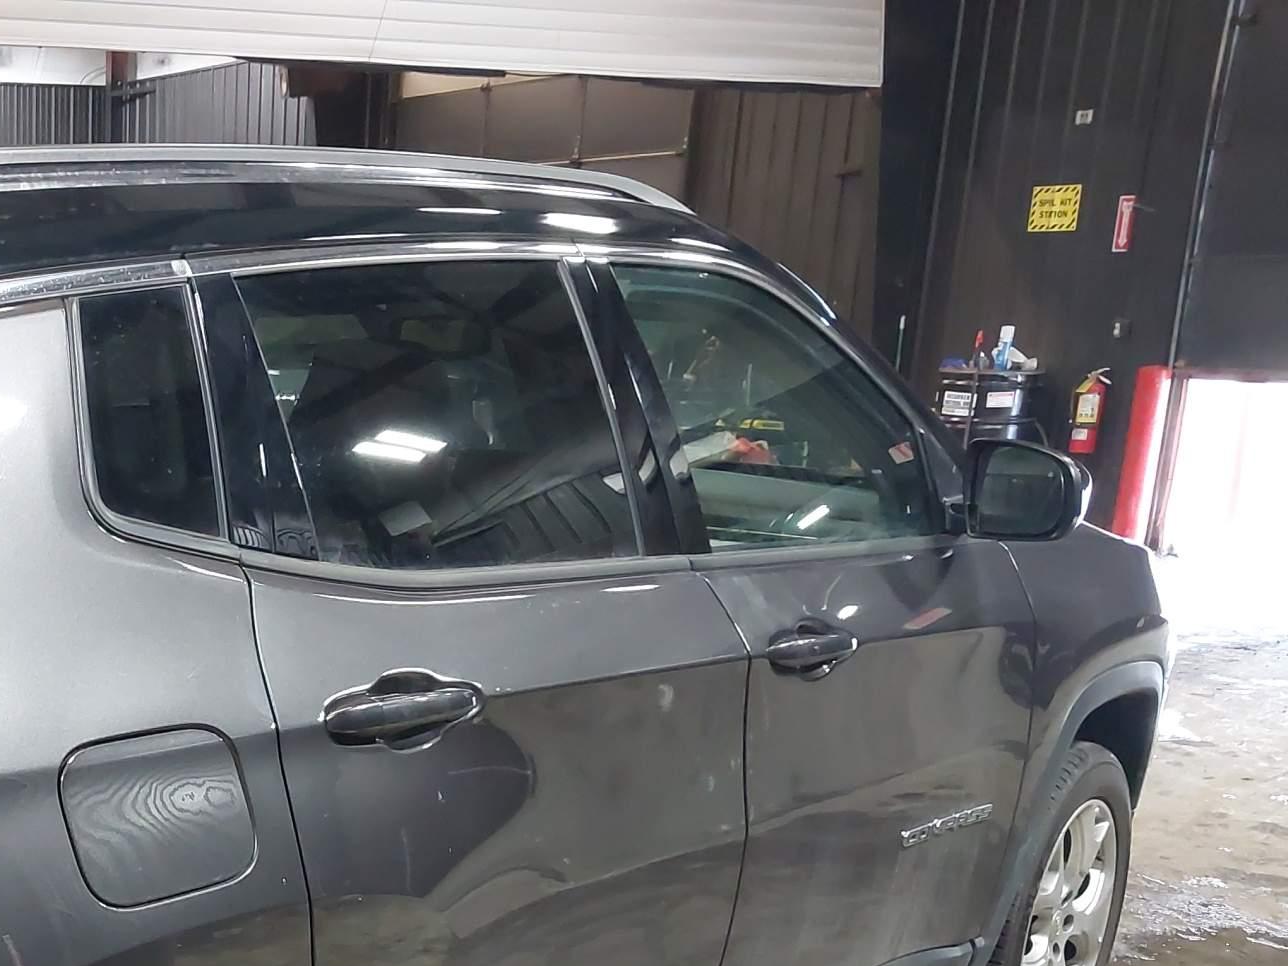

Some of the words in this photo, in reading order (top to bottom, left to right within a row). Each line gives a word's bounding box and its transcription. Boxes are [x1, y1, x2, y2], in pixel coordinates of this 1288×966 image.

[1059, 198, 1072, 206] KIT
[1039, 210, 1068, 218] STATION
[900, 803, 993, 847] COMPASS
